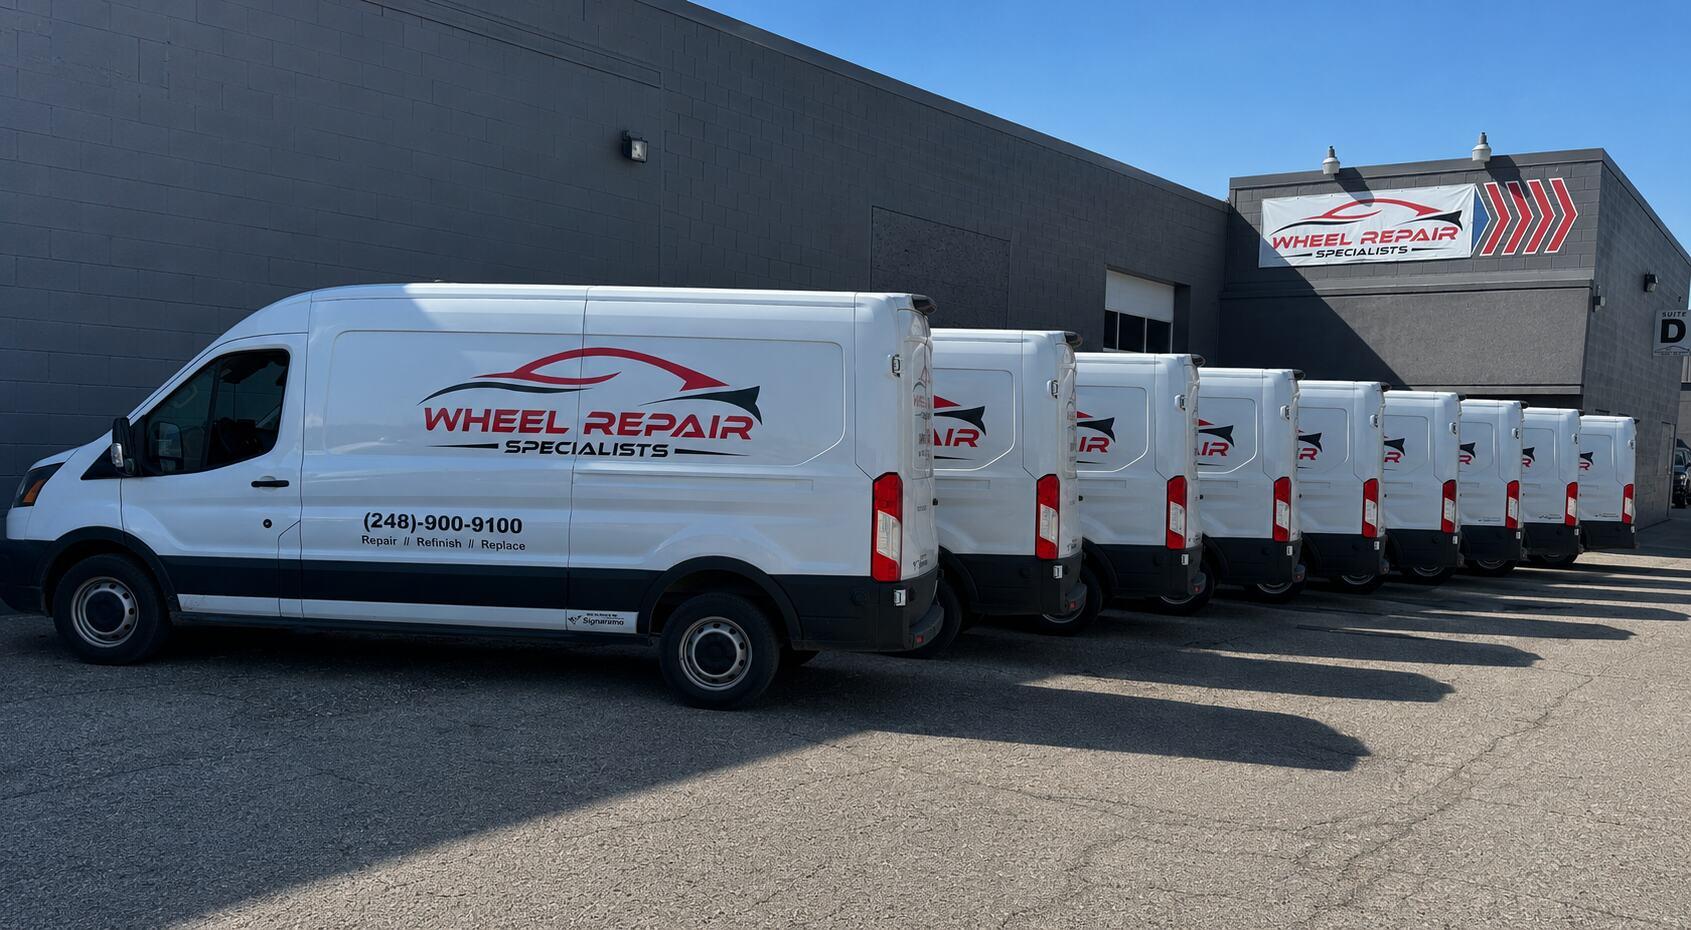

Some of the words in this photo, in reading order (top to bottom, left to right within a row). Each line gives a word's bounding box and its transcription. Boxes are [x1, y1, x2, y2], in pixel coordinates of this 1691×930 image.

[1272, 234, 1352, 249] WHEEL
[1360, 226, 1458, 245] REPAIR
[1315, 246, 1409, 258] SPECIALISTS
[1661, 318, 1686, 343] D
[424, 407, 571, 434] WHEEL
[583, 411, 754, 440] REPAIR
[504, 440, 669, 458] SPECIALISTS
[363, 512, 523, 534] (248)-900-9100
[361, 535, 398, 547] Repair
[416, 537, 462, 549] Refinish
[481, 539, 526, 551] Replace
